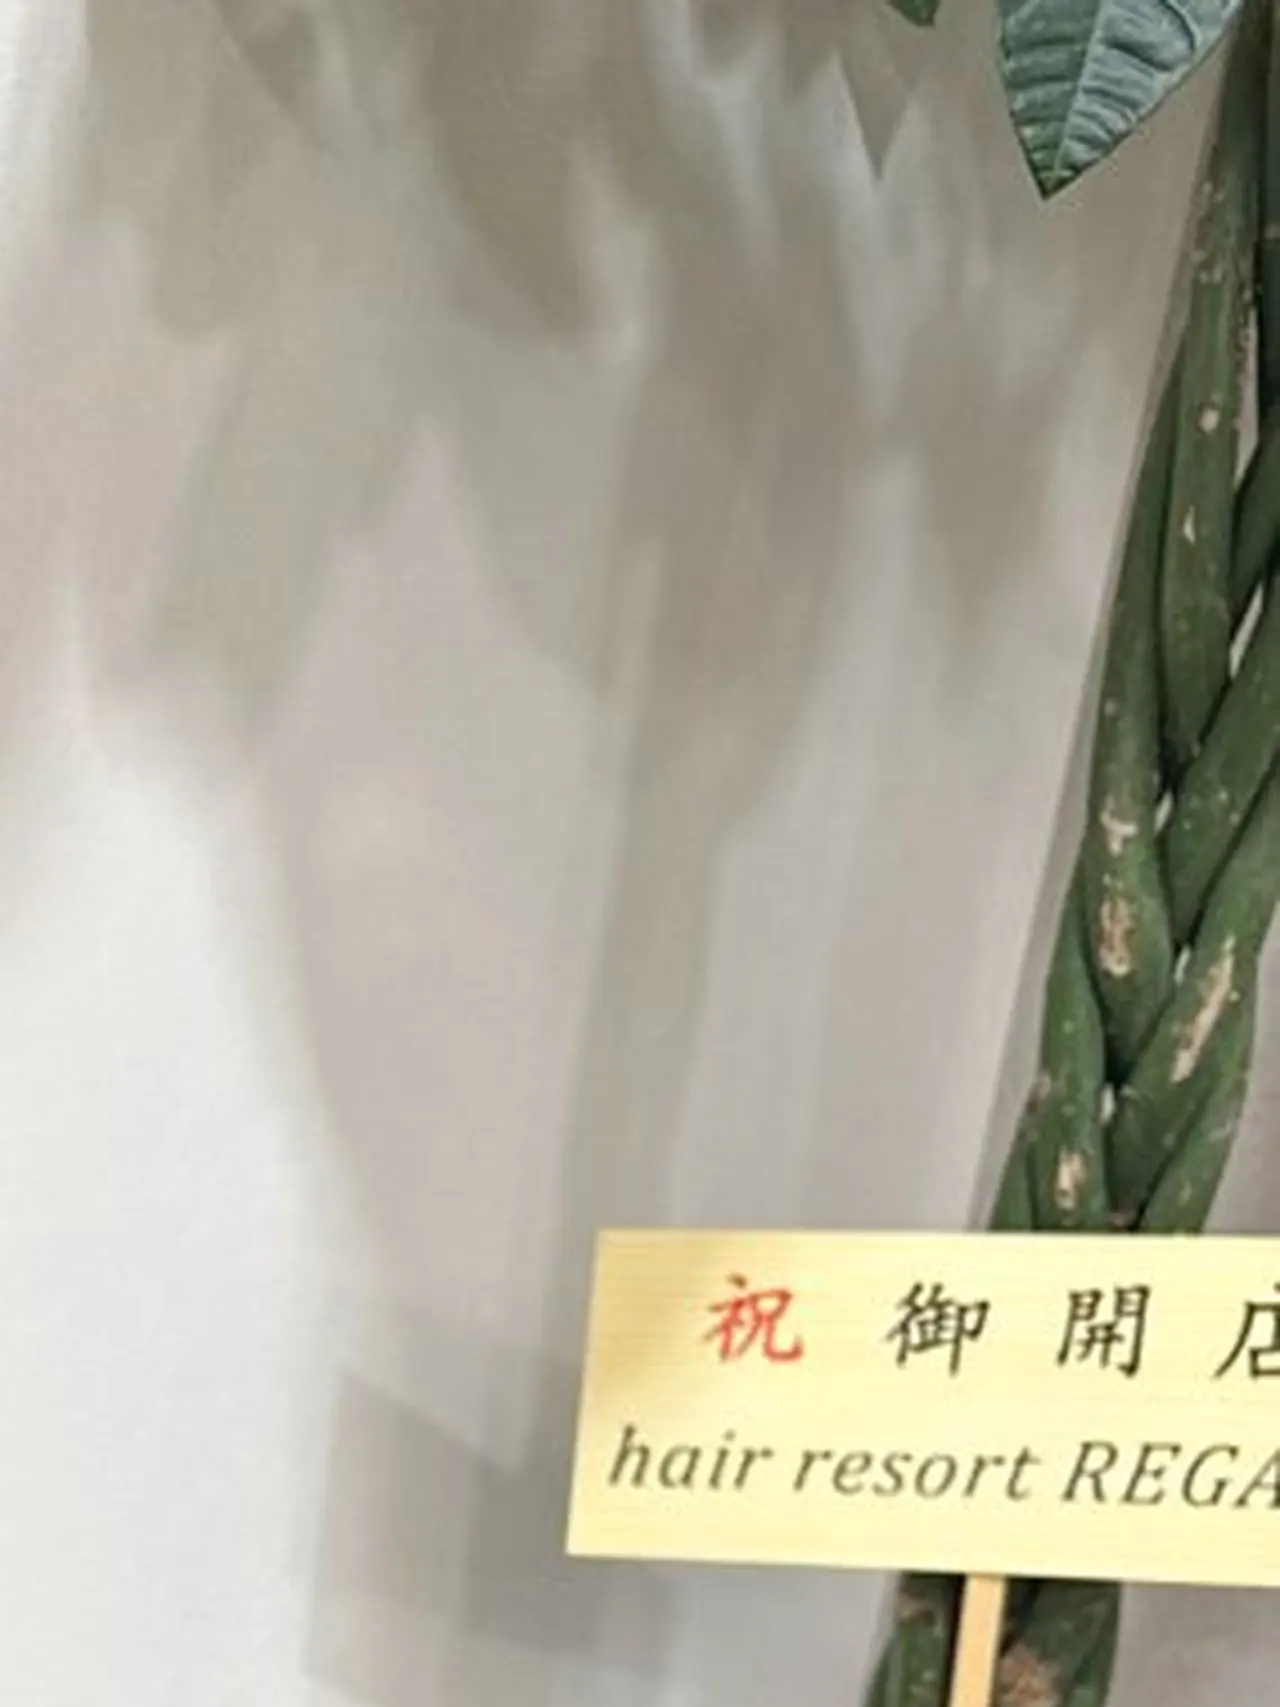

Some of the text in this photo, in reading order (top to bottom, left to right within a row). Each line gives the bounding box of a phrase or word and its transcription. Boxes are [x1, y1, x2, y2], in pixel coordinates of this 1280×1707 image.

[608, 1422, 1280, 1509] hair resort REGA
